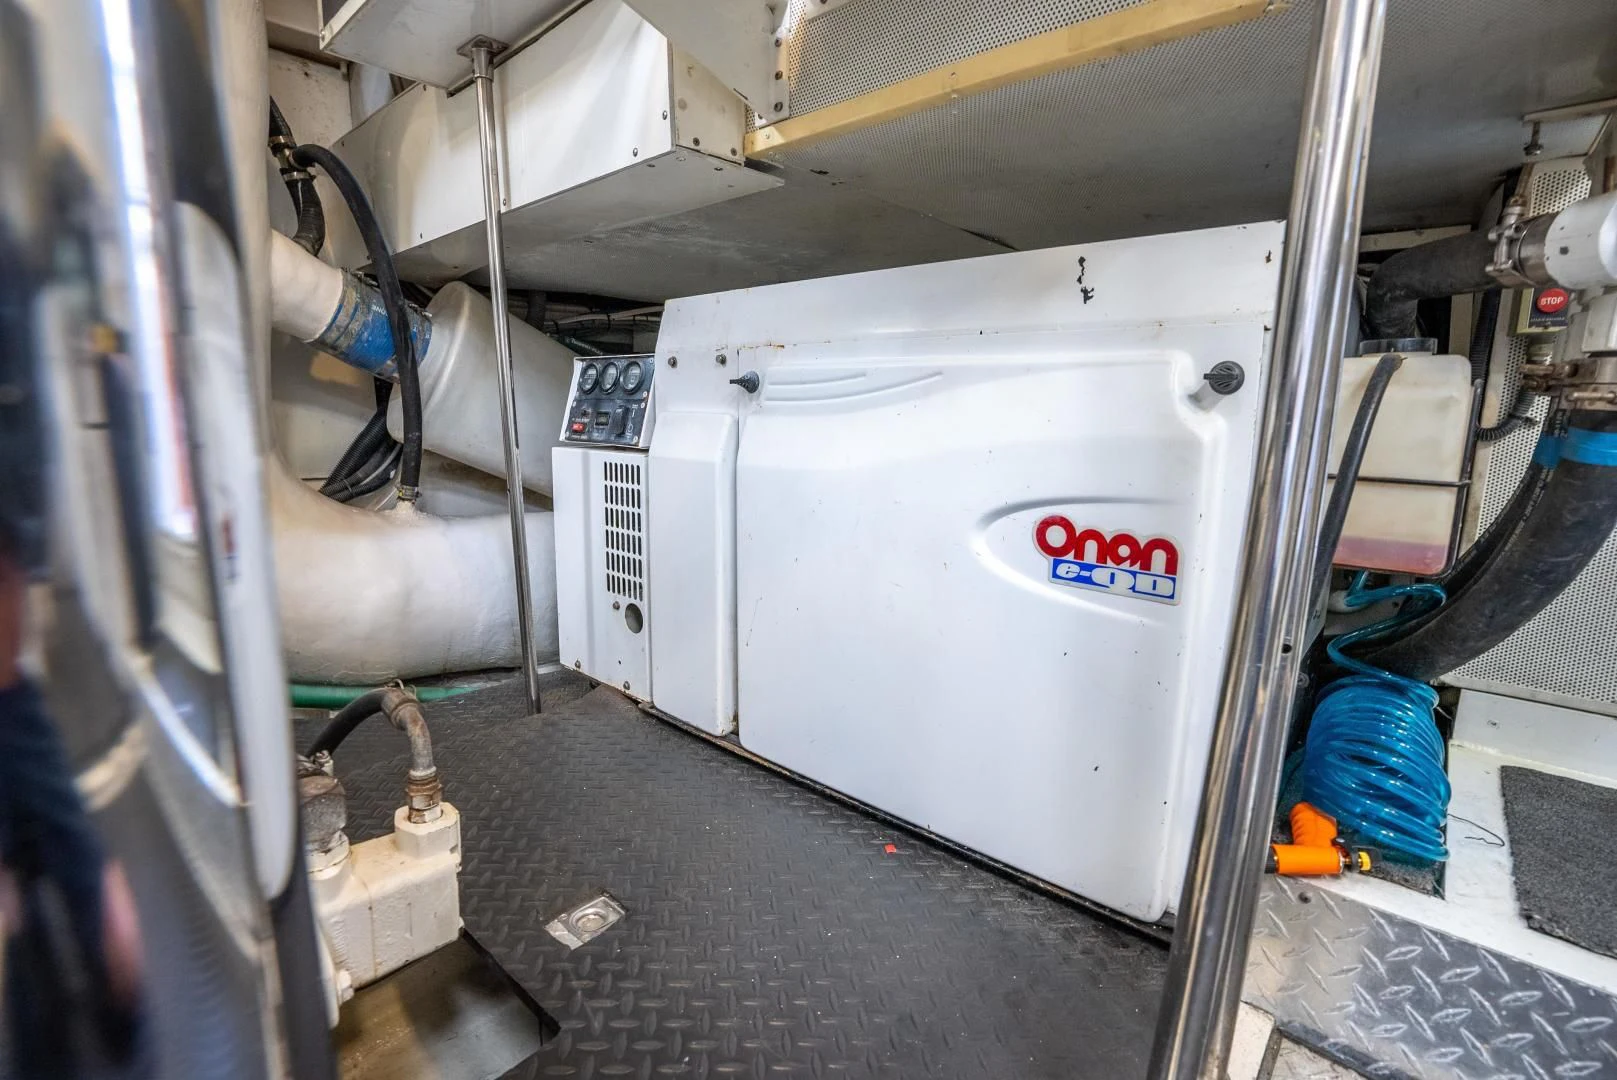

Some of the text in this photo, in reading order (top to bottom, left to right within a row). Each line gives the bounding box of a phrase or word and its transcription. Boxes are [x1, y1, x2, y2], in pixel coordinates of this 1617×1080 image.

[1540, 296, 1564, 306] STOP
[1036, 515, 1179, 576] Onan
[1055, 562, 1175, 597] e-QD
